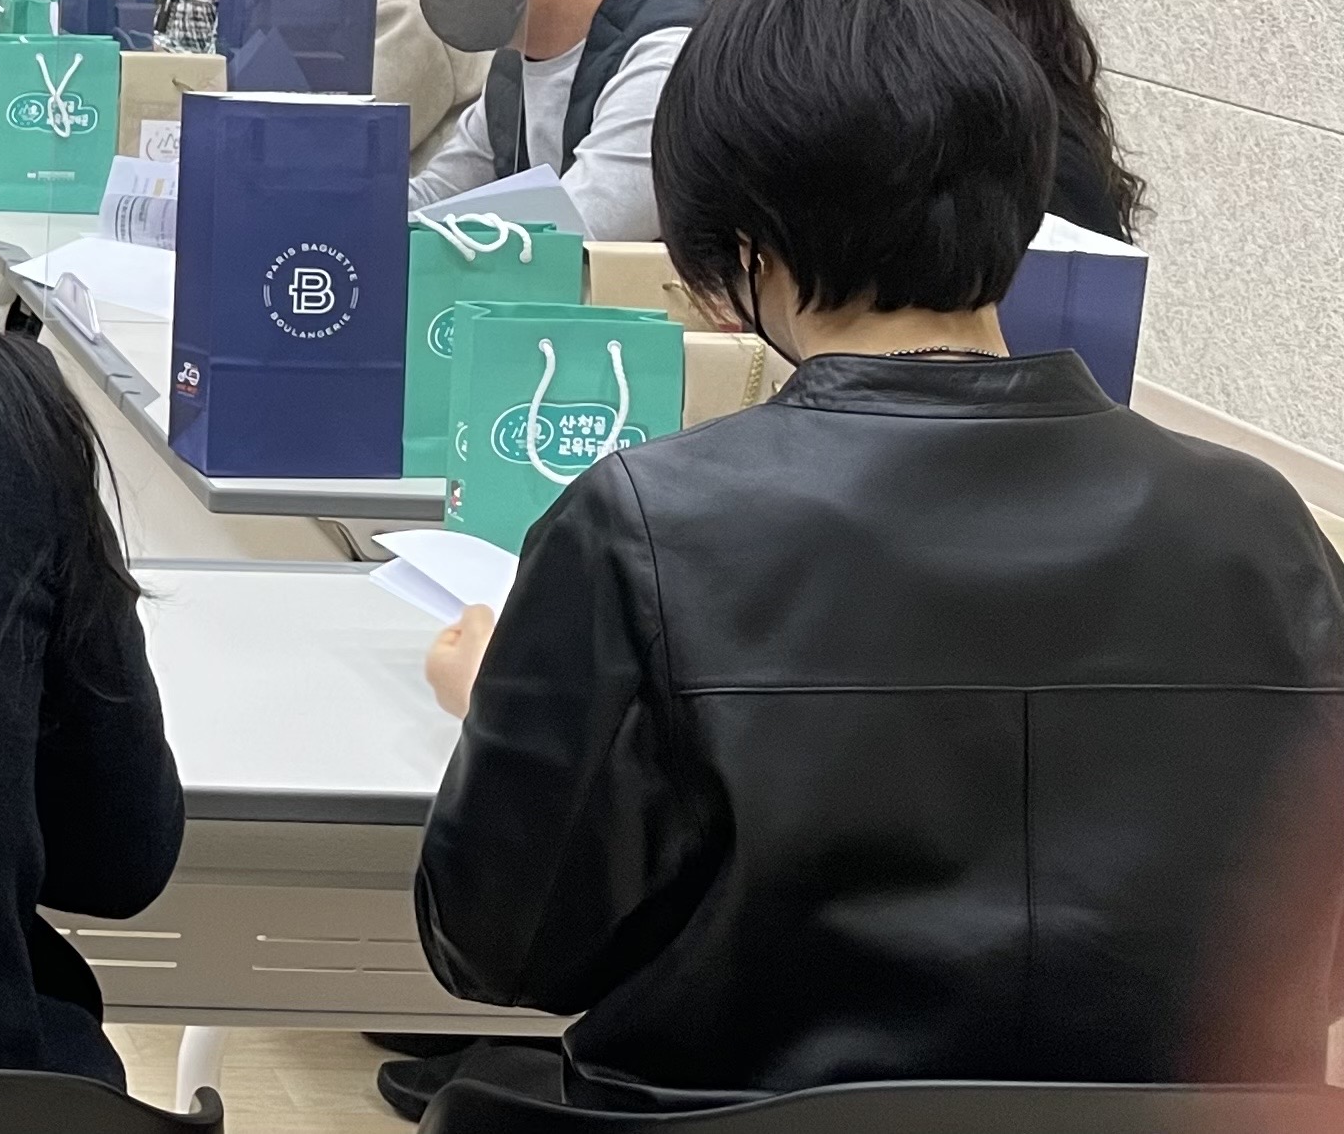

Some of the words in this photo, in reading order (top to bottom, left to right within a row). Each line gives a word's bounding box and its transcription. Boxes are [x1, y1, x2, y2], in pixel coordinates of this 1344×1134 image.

[265, 247, 296, 280] PARIS
[300, 242, 359, 282] BAGUETTE
[288, 267, 336, 315] B
[269, 311, 352, 340] BOULANGERIE
[558, 413, 608, 436] 산청골
